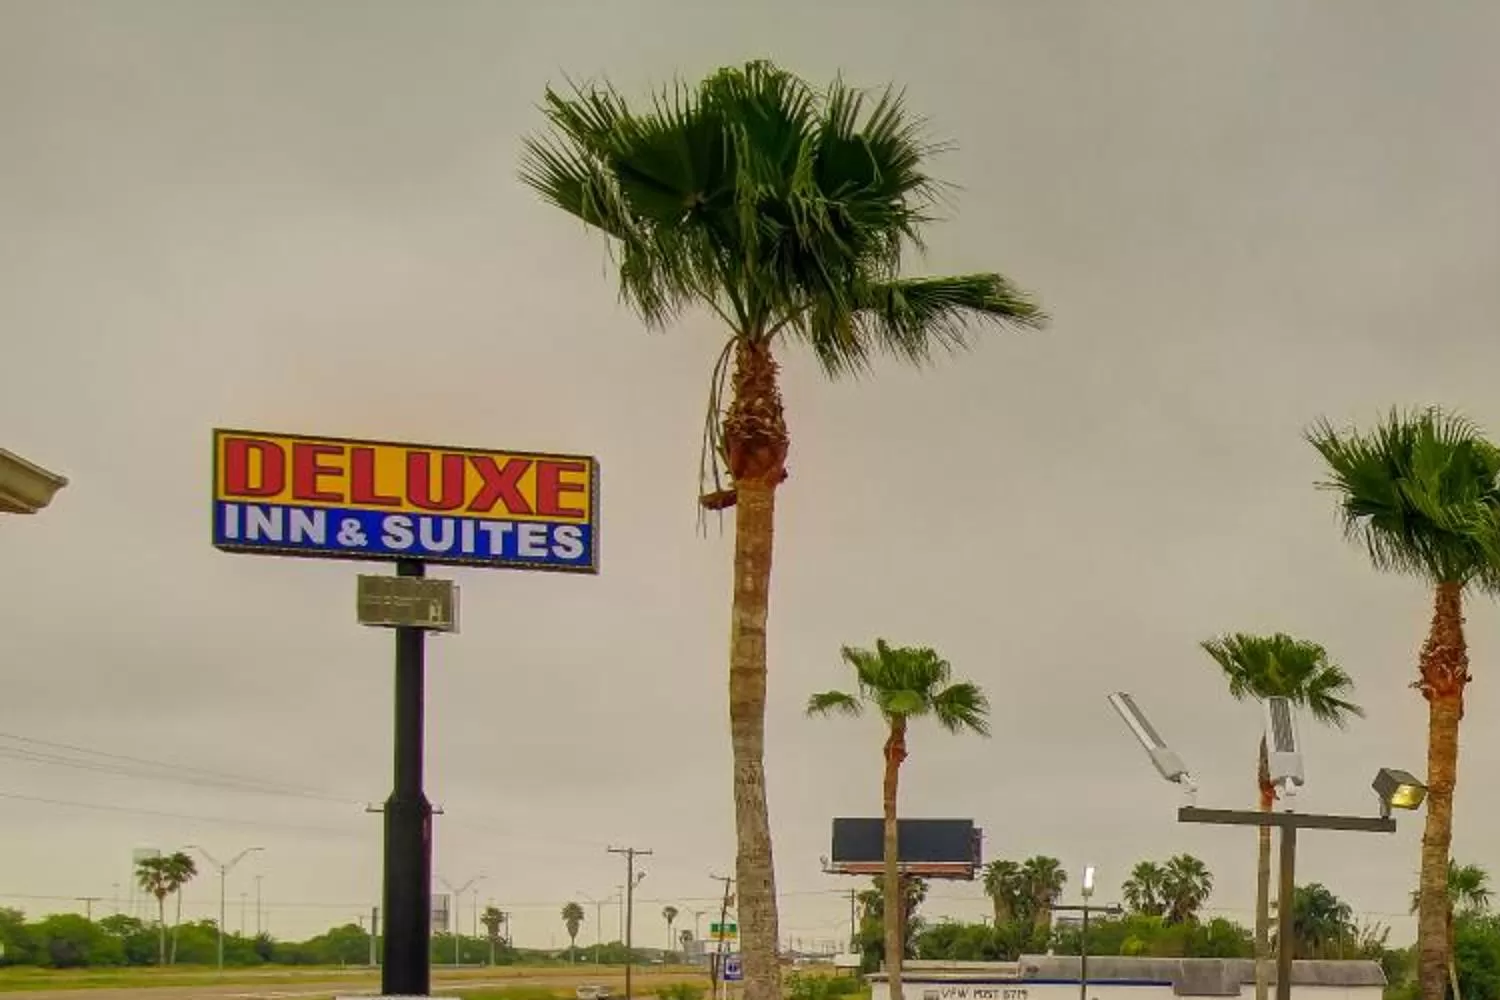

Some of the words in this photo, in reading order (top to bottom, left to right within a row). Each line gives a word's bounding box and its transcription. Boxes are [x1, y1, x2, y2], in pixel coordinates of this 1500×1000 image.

[223, 437, 586, 518] DELUXE
[224, 503, 327, 545] INN
[336, 517, 369, 547] &
[381, 514, 585, 559] SUITES
